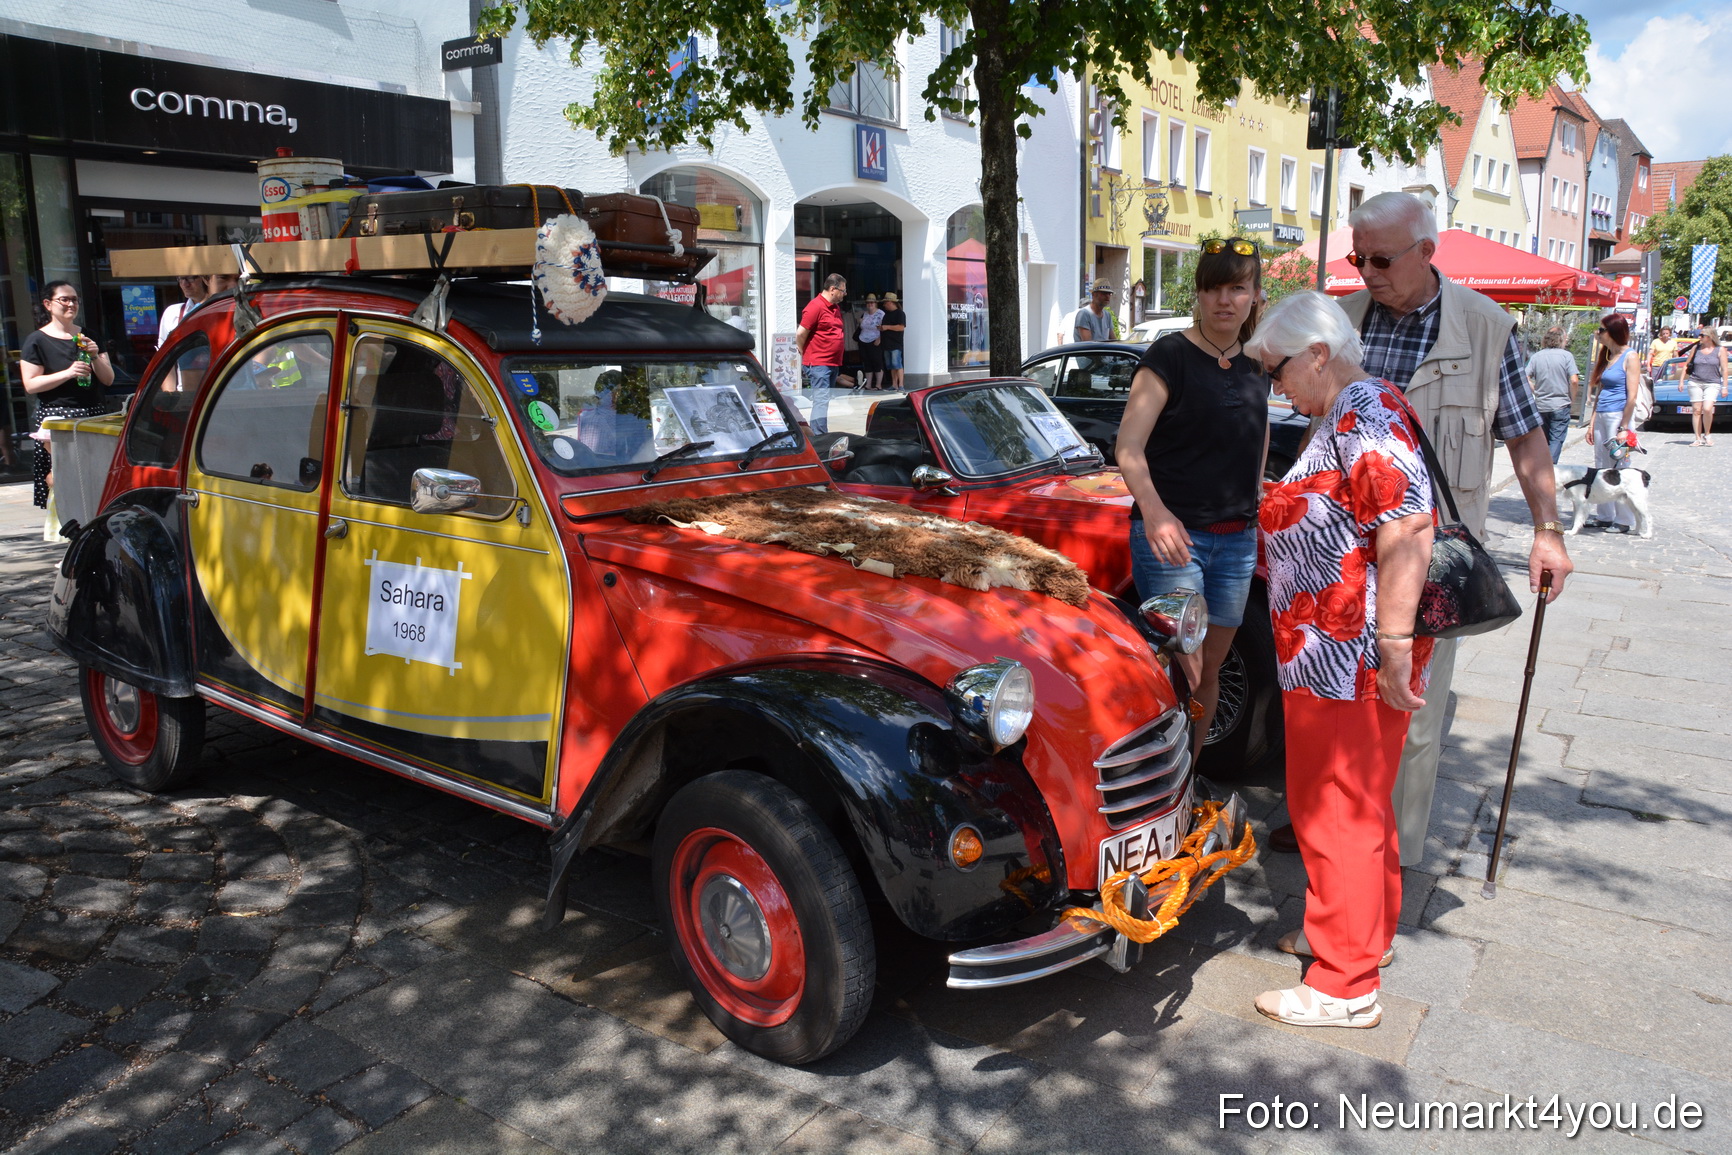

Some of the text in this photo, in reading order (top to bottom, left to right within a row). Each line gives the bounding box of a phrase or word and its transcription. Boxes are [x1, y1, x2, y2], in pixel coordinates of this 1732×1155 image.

[445, 43, 494, 60] comma,
[1151, 76, 1184, 112] HOTEL
[130, 87, 298, 134] comma,
[1278, 226, 1305, 242] TAIFUN
[1467, 276, 1510, 285] Restaurant
[1511, 276, 1550, 285] Lehmeier
[535, 408, 546, 424] 5
[380, 580, 444, 612] Sahara
[393, 620, 426, 643] 1968
